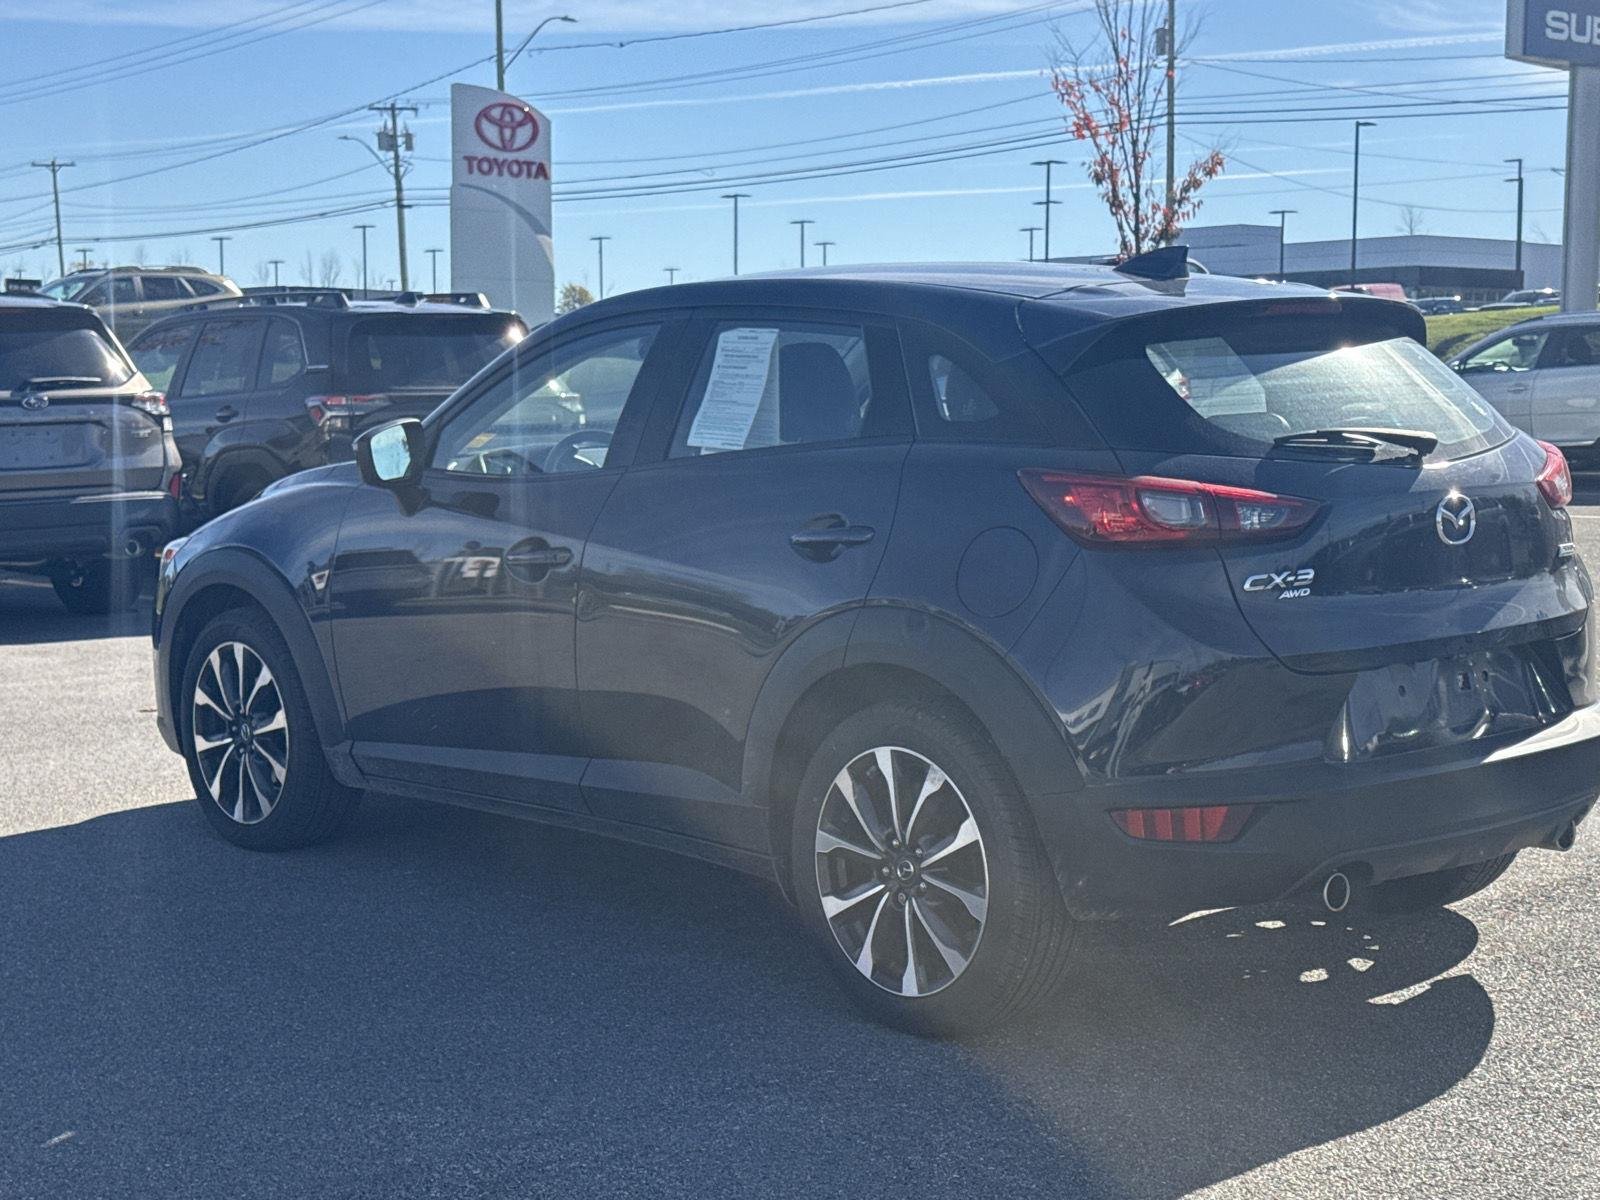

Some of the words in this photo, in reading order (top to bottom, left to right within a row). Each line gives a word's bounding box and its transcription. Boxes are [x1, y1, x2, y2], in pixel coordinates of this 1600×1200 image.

[463, 155, 550, 180] TOYOTA
[1243, 568, 1315, 592] CX-3
[1278, 588, 1311, 600] AWD
